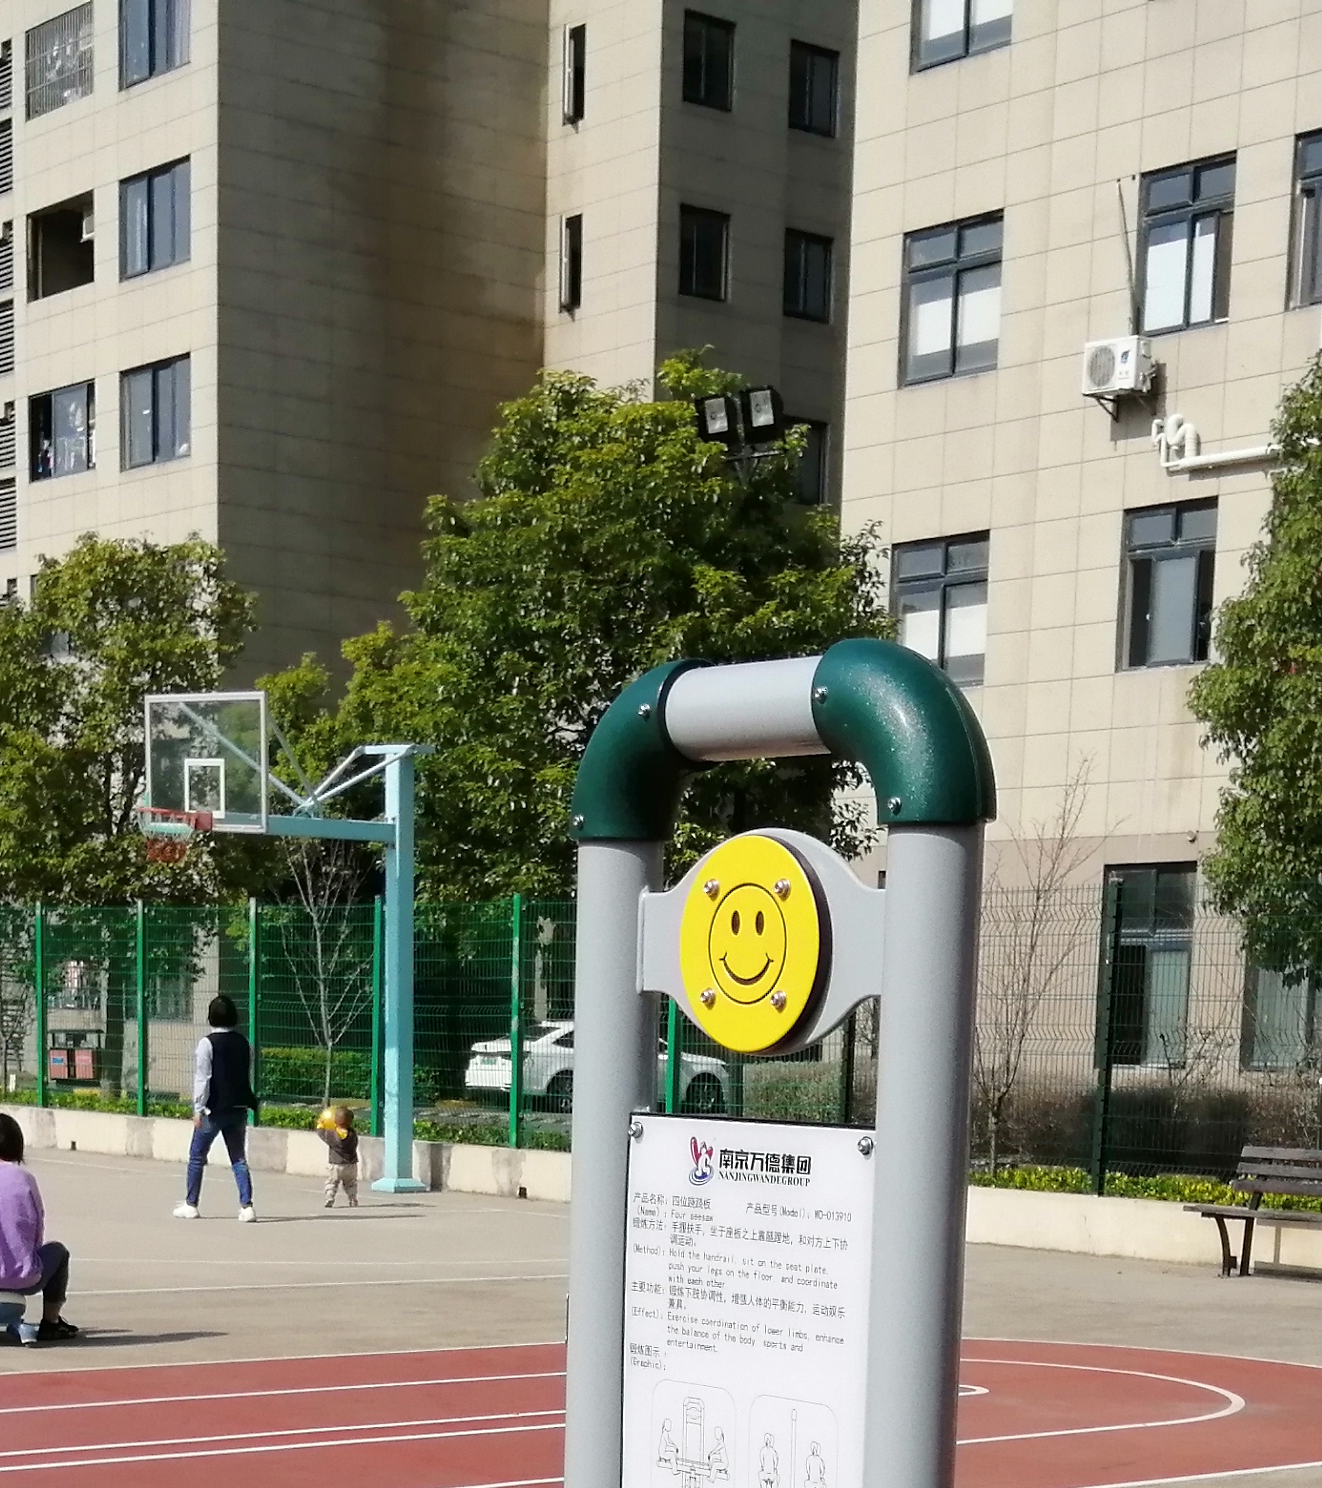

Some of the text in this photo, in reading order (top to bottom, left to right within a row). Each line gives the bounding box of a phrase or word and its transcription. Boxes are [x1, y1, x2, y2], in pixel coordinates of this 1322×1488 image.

[719, 1147, 811, 1175] 南京万德集团
[718, 1170, 810, 1187] NANJINGWANDEGROUP
[670, 1209, 686, 1219] Four
[669, 1248, 684, 1257] Hold
[688, 1250, 700, 1259] the
[742, 1256, 754, 1266] sit
[770, 1259, 782, 1269] the
[785, 1262, 801, 1271] seat
[668, 1260, 684, 1272] push
[687, 1265, 703, 1274] your
[707, 1265, 722, 1277] legs
[725, 1268, 734, 1277] on
[737, 1268, 749, 1279] the
[780, 1273, 793, 1284] and
[796, 1275, 837, 1289] coordinate
[668, 1272, 683, 1283] with
[687, 1275, 703, 1286] each
[667, 1311, 698, 1324] Exercise
[701, 1316, 748, 1331] coordination
[751, 1322, 760, 1333] of
[764, 1324, 783, 1336] lower
[815, 1332, 844, 1345] enhance
[667, 1324, 678, 1334] the
[681, 1325, 709, 1339] balance
[712, 1329, 720, 1341] of
[724, 1331, 736, 1343] the
[763, 1339, 786, 1350] sports
[790, 1341, 803, 1352] and
